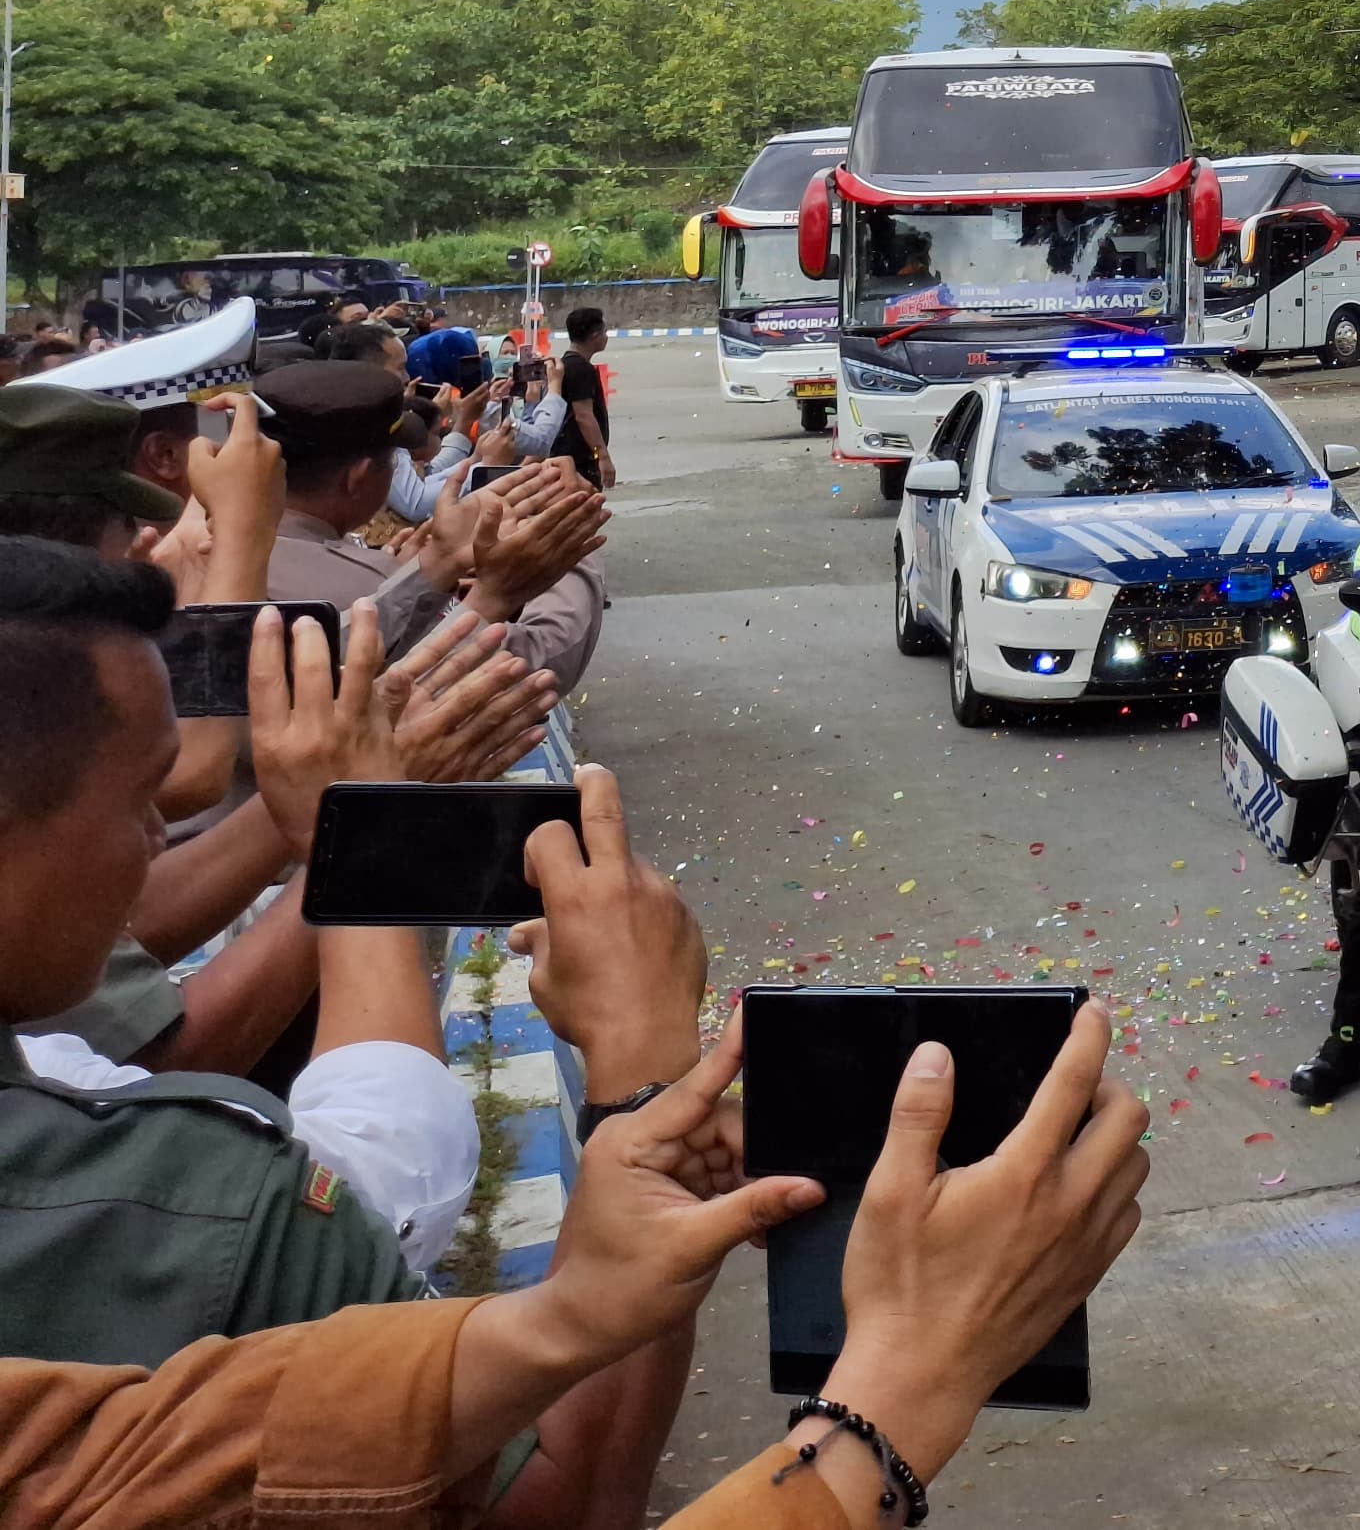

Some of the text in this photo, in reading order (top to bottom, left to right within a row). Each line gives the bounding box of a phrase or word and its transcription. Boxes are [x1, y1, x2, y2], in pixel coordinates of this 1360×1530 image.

[948, 81, 1096, 94] PARIWISATA
[957, 294, 1147, 314] WONOGIRI-JAKART
[1102, 395, 1151, 405] POLRES
[1153, 395, 1217, 405] WONOGIRI
